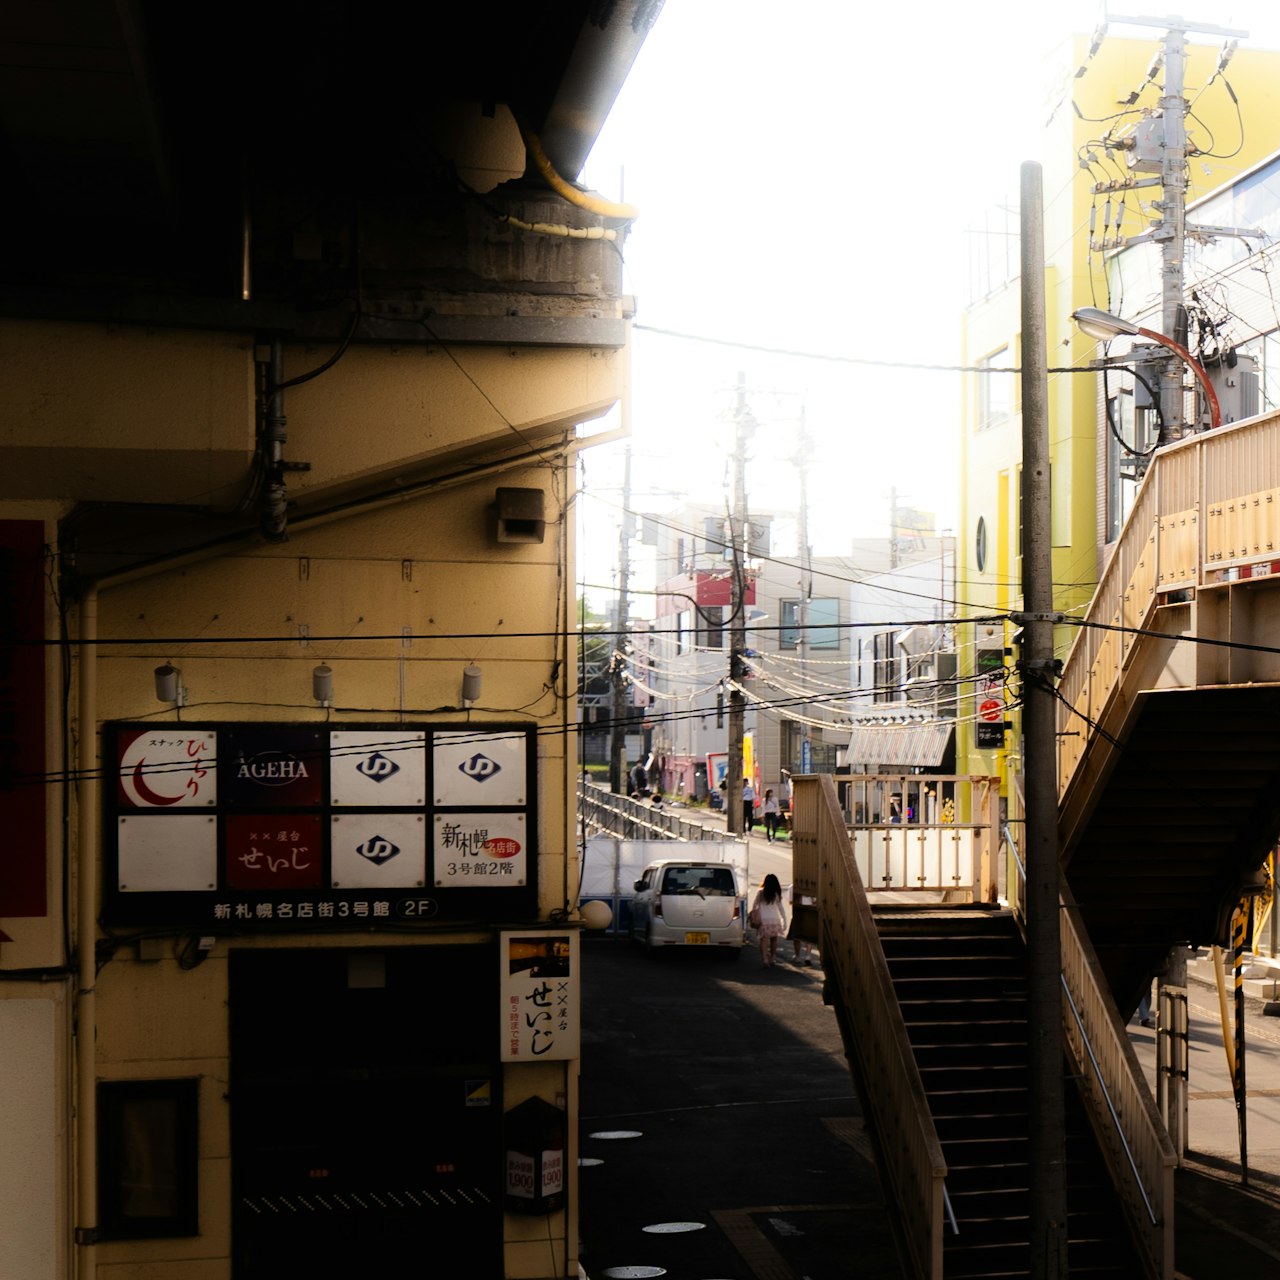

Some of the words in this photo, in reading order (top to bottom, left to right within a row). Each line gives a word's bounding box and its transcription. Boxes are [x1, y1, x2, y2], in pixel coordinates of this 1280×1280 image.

[149, 739, 184, 747] スナック
[187, 739, 208, 798] ひらり
[237, 761, 309, 778] AGEHA
[441, 823, 490, 857] 新札幌
[238, 847, 311, 873] せいじ
[447, 862, 514, 876] 3号館2階
[214, 902, 390, 920] 新札幌名店街3号館
[405, 901, 430, 915] 2F
[525, 981, 555, 1056] せいじ
